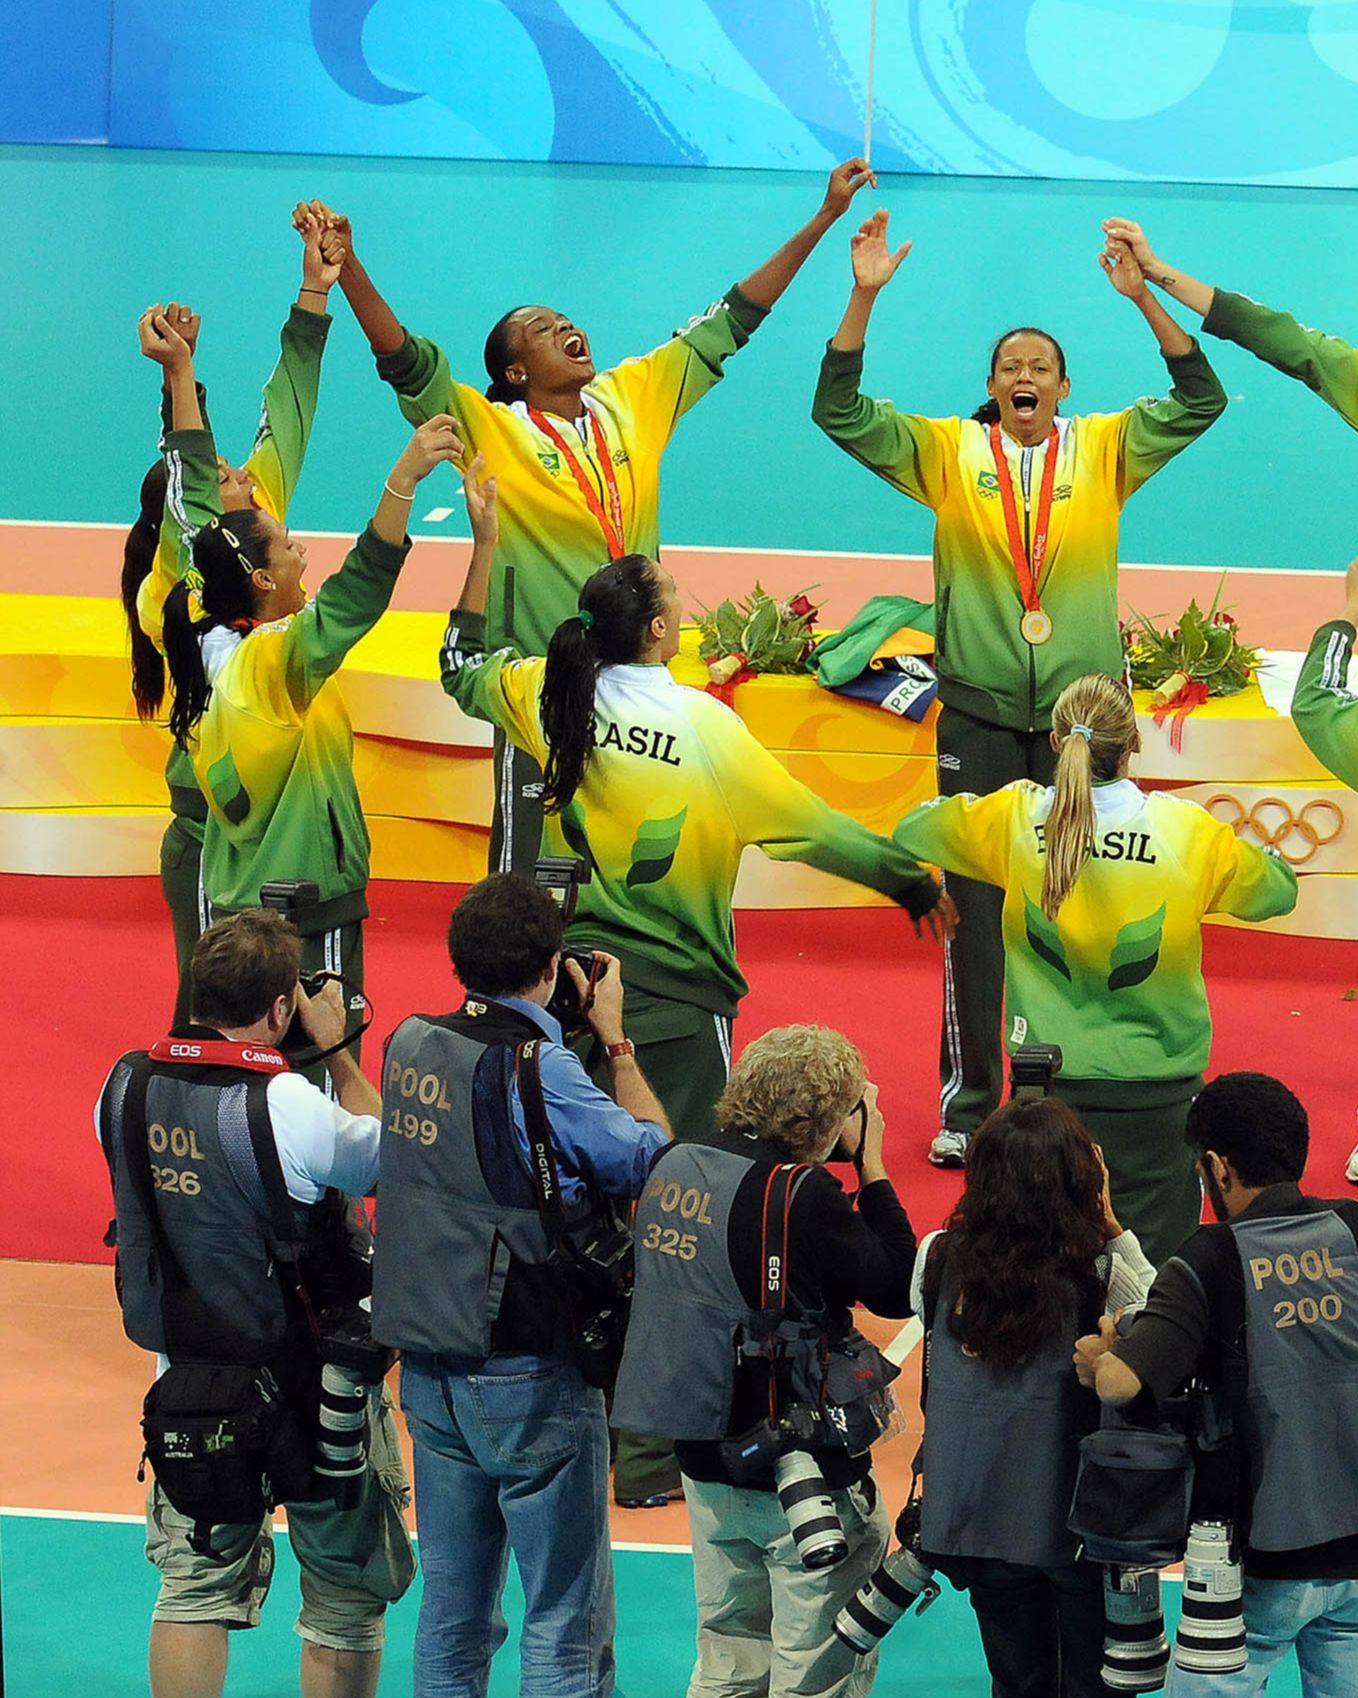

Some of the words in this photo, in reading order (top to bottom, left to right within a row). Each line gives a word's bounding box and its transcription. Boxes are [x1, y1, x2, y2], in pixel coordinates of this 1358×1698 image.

[592, 721, 681, 767] ASIL
[1034, 824, 1157, 865] BSIL
[169, 1044, 201, 1058] EOS
[241, 1050, 284, 1067] Canon
[387, 1059, 452, 1113] POOL
[149, 1122, 207, 1161] OOL
[388, 1108, 438, 1147] 199
[535, 1142, 555, 1200] DIGITAL
[644, 1177, 713, 1226] POOL
[642, 1222, 699, 1262] 325
[767, 1255, 781, 1292] EOS
[1248, 1246, 1345, 1292] POOL
[1272, 1293, 1343, 1329] 200
